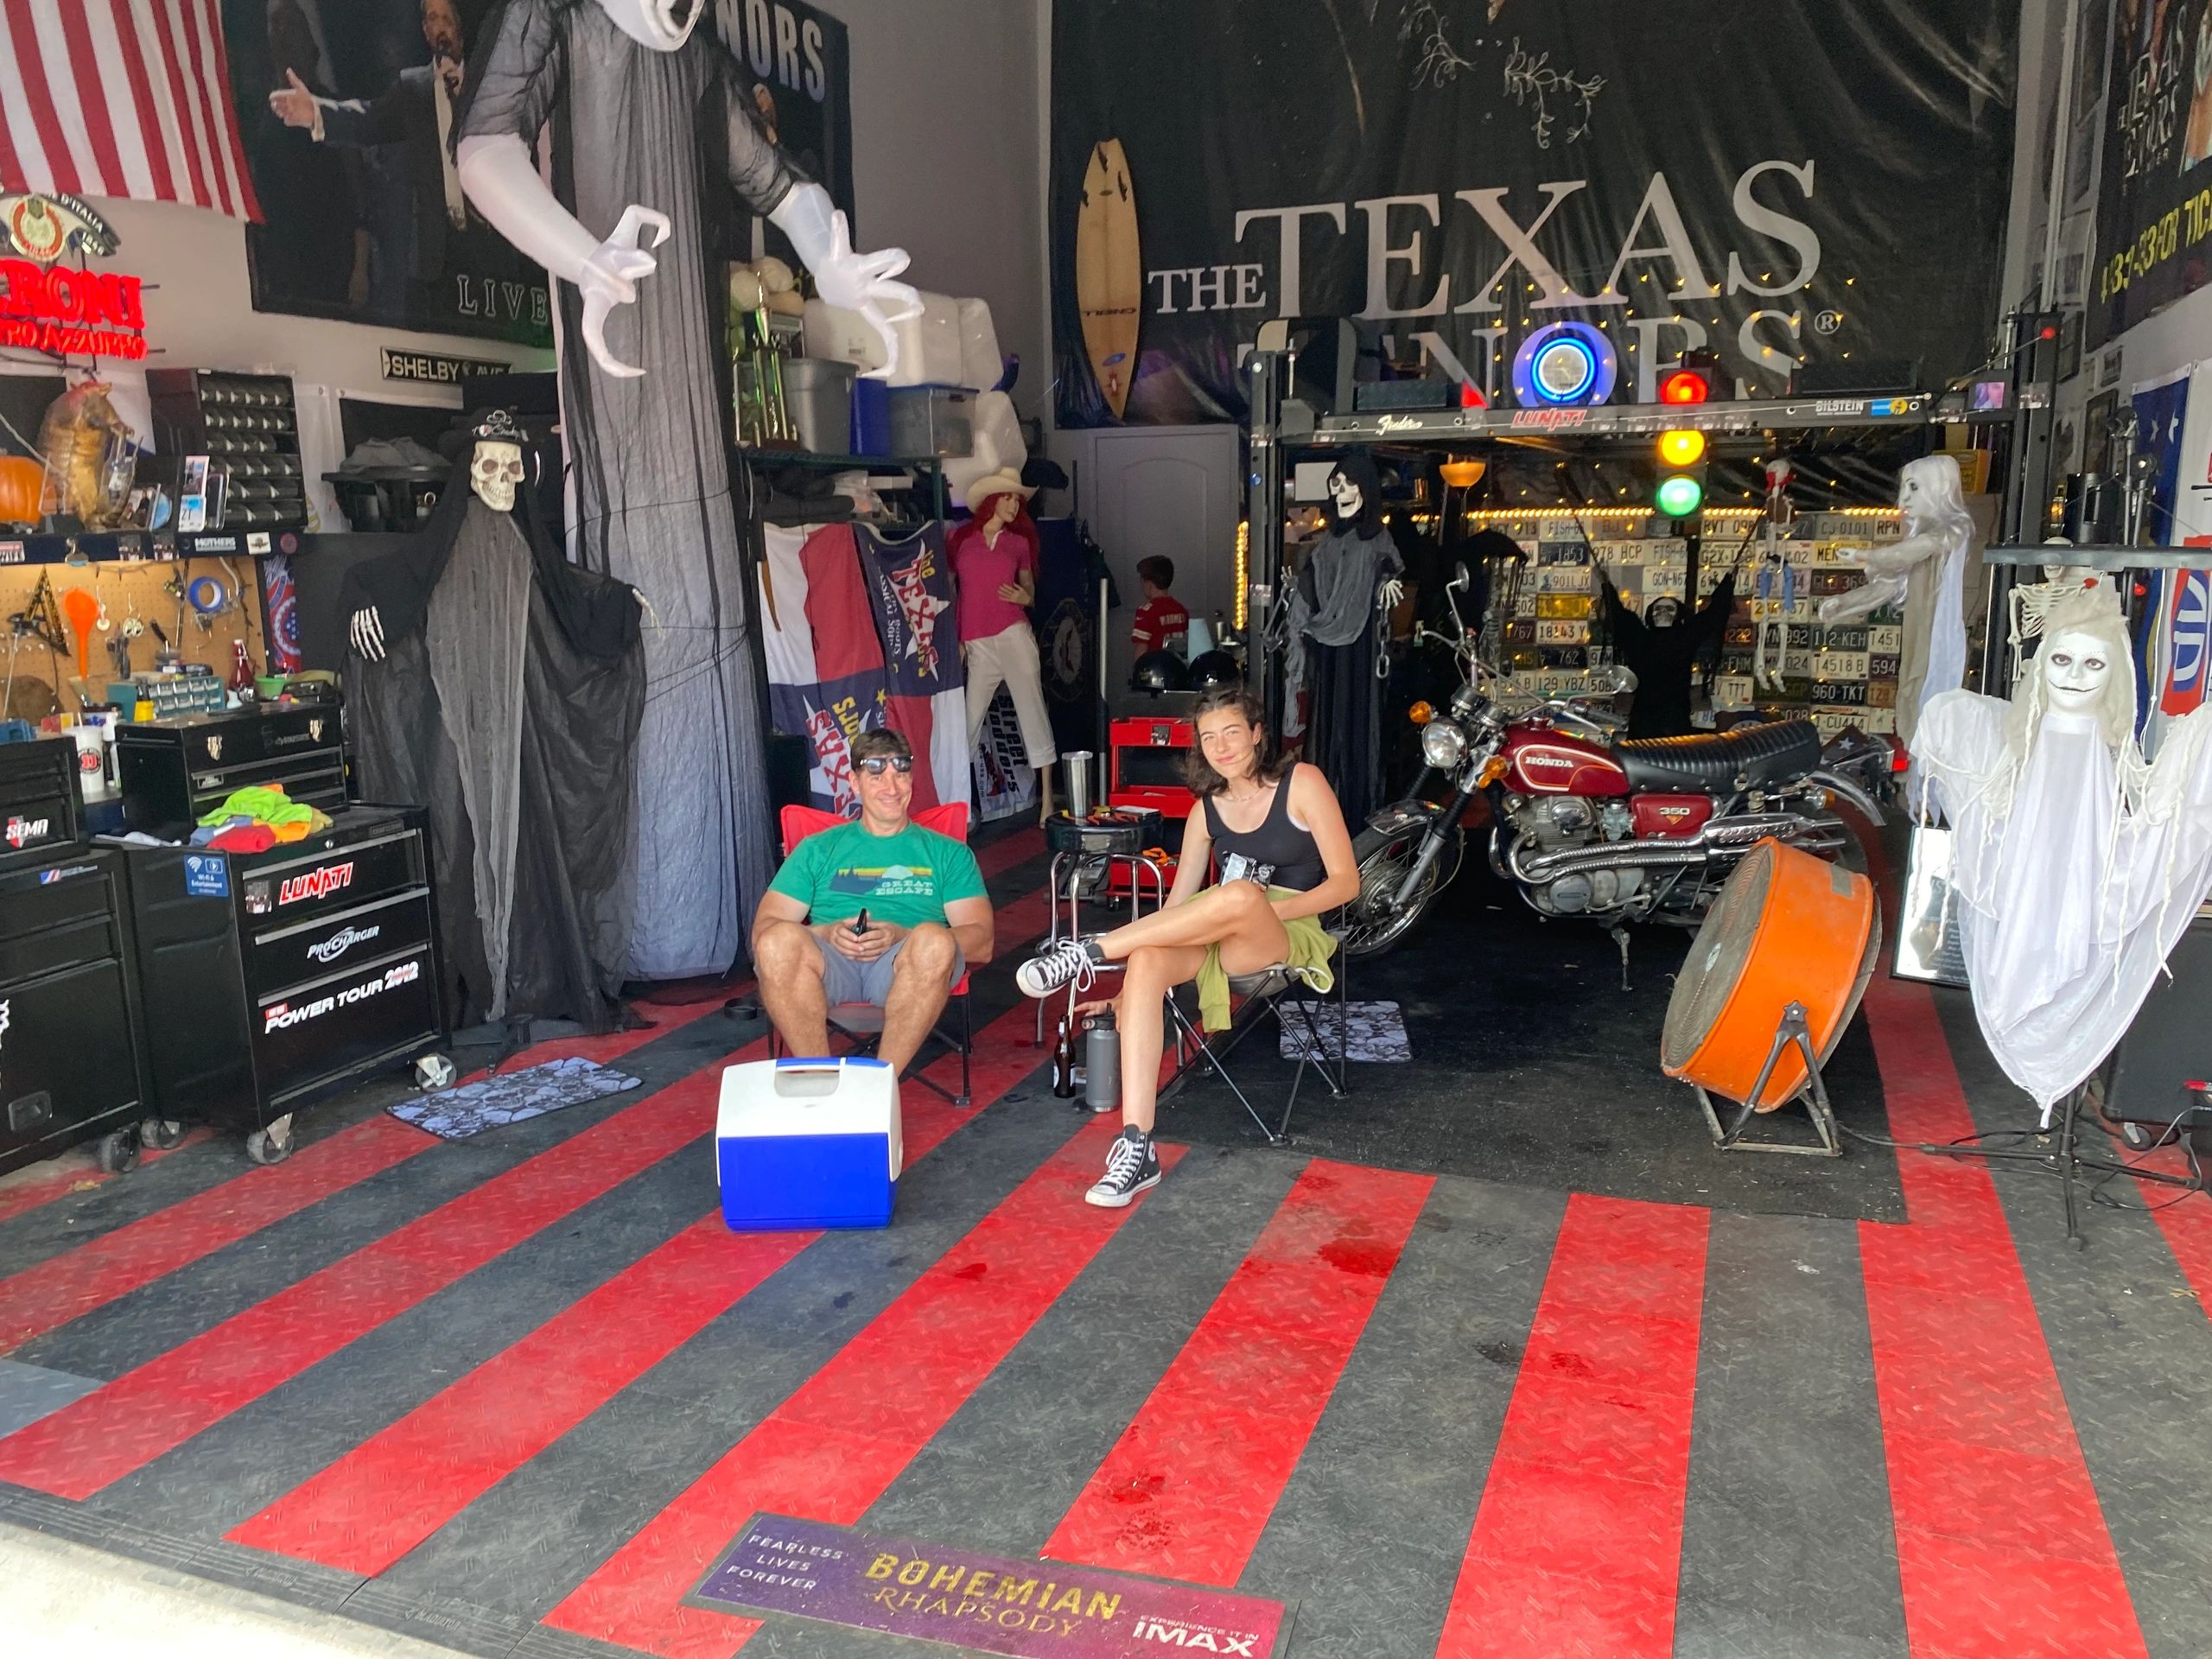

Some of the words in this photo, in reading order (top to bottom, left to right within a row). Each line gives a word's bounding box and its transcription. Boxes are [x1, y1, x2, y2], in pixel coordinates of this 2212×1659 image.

[715, 0, 825, 102] NORS
[1147, 264, 1267, 314] THE
[1235, 159, 1822, 320] TEXAS
[457, 274, 548, 325] LIVE
[391, 354, 460, 381] SHELBY
[1815, 400, 1865, 412] BILSTEIN
[1510, 408, 1587, 431] LUNATI
[194, 537, 236, 551] MOTHERS
[1621, 544, 1642, 560] HCP
[1872, 659, 1897, 674] 594
[1841, 685, 1865, 701] TKT
[1525, 756, 1574, 768] HONDA
[5, 818, 49, 841] SEMA
[278, 861, 354, 905] LUNATI
[875, 887, 933, 896] ESCAPE
[881, 880, 933, 888] GREAT
[307, 925, 380, 962] PROCHARGER
[264, 996, 335, 1034] POWER
[337, 979, 384, 1007] TOUR
[747, 1534, 843, 1560] FEARLESS
[755, 1554, 810, 1572] LIVES
[726, 1565, 817, 1591] FOREVER
[865, 1554, 1122, 1620] BOHEMIAN
[874, 1586, 1084, 1638] RHAPSODY
[1140, 1615, 1226, 1636] EXPERIENCE
[1132, 1621, 1256, 1657] IMAX
